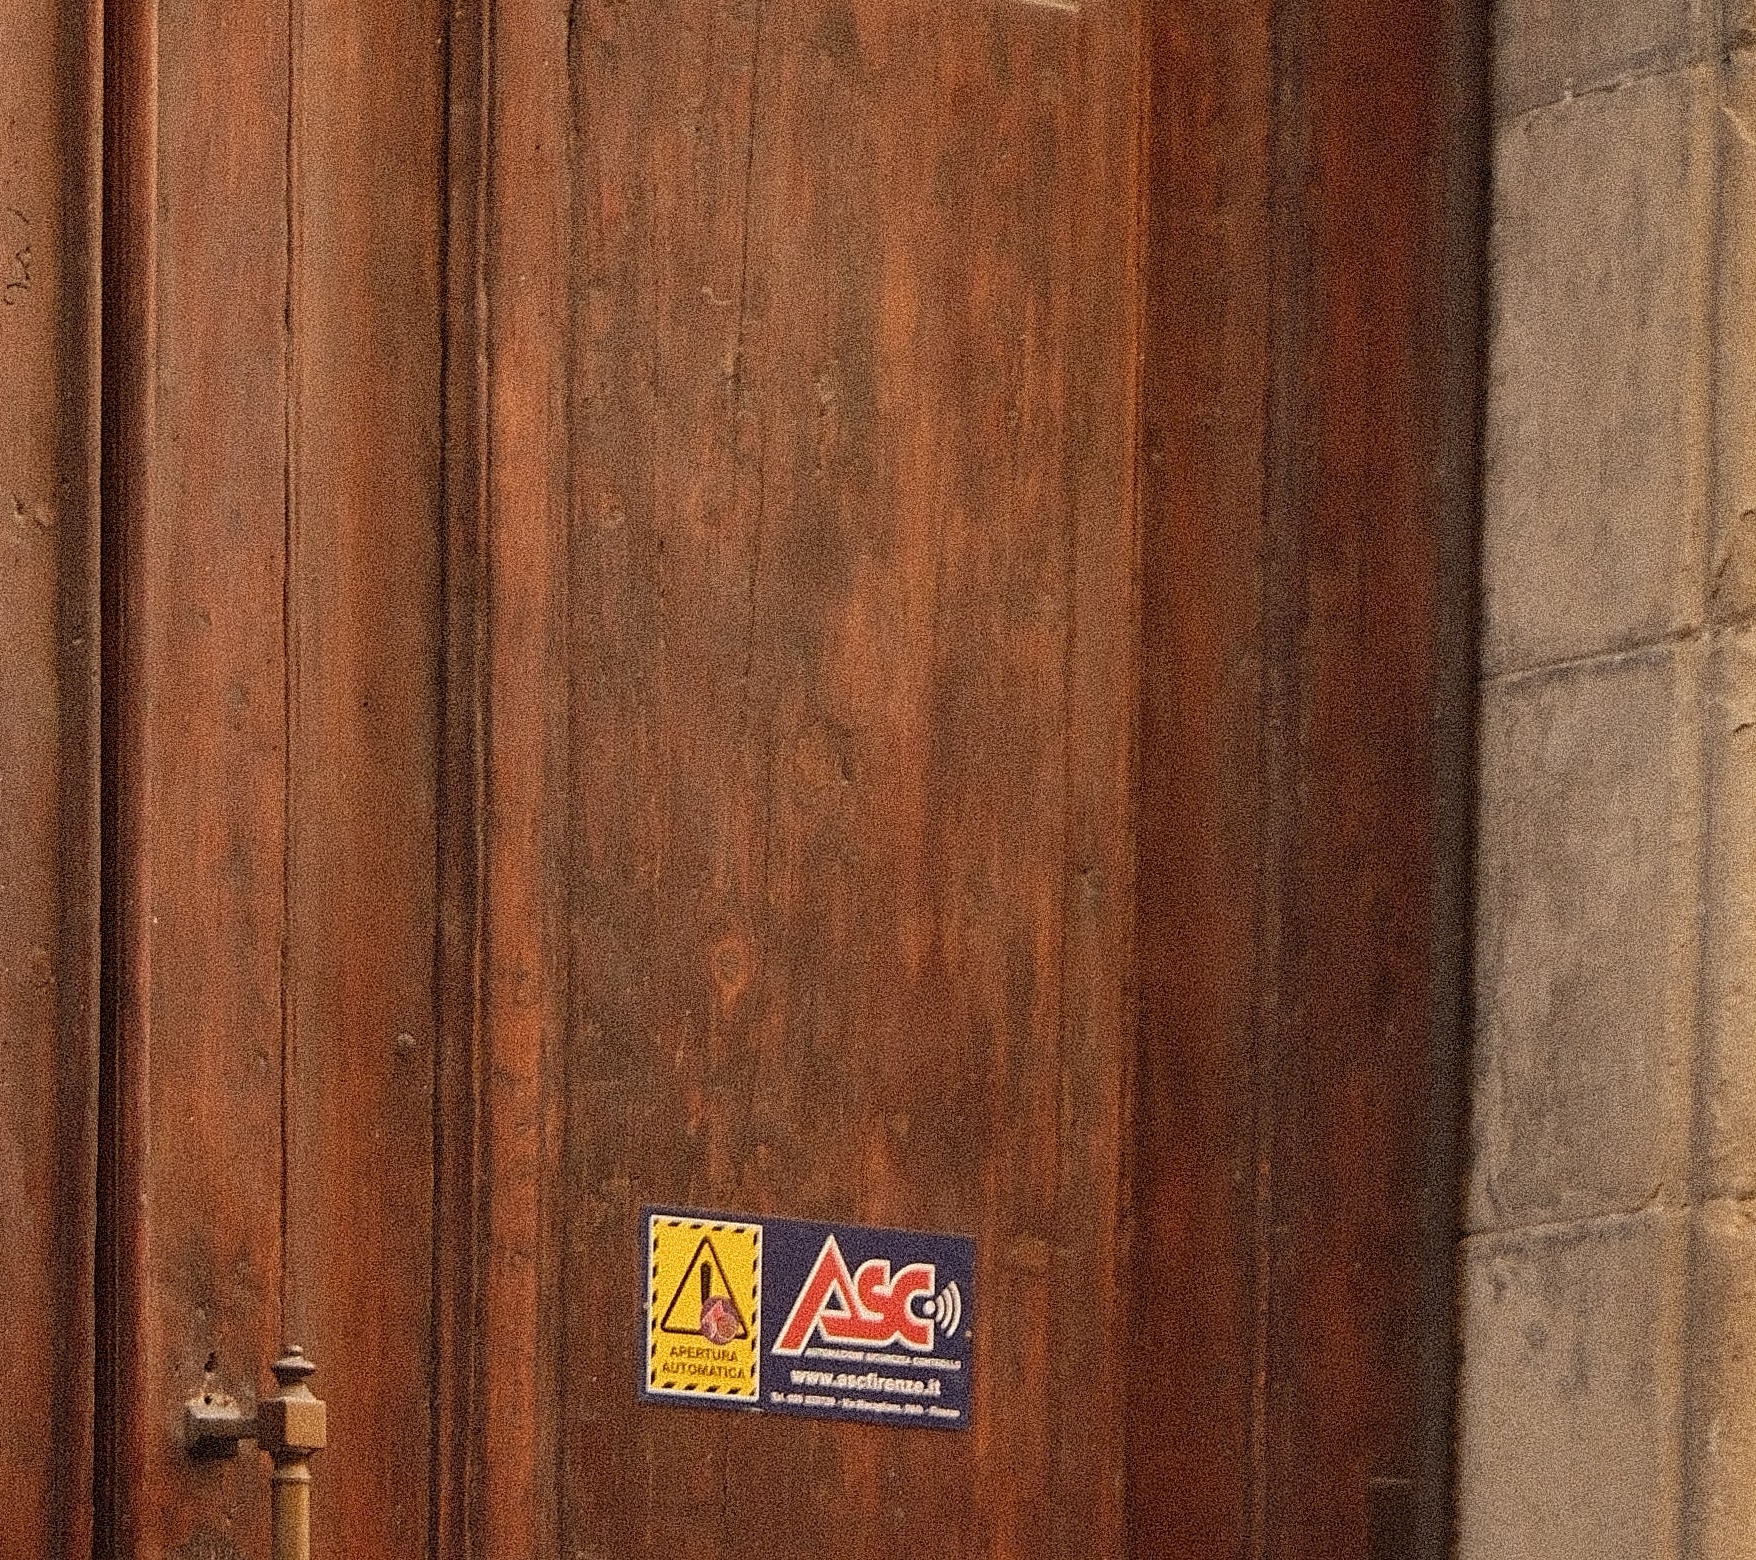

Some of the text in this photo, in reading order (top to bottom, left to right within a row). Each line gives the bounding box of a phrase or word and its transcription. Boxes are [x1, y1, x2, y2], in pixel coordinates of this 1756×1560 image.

[670, 1346, 738, 1361] APERTURA
[662, 1360, 745, 1379] AUTOMATICA
[791, 1370, 941, 1396] www.ascfirenze.it
